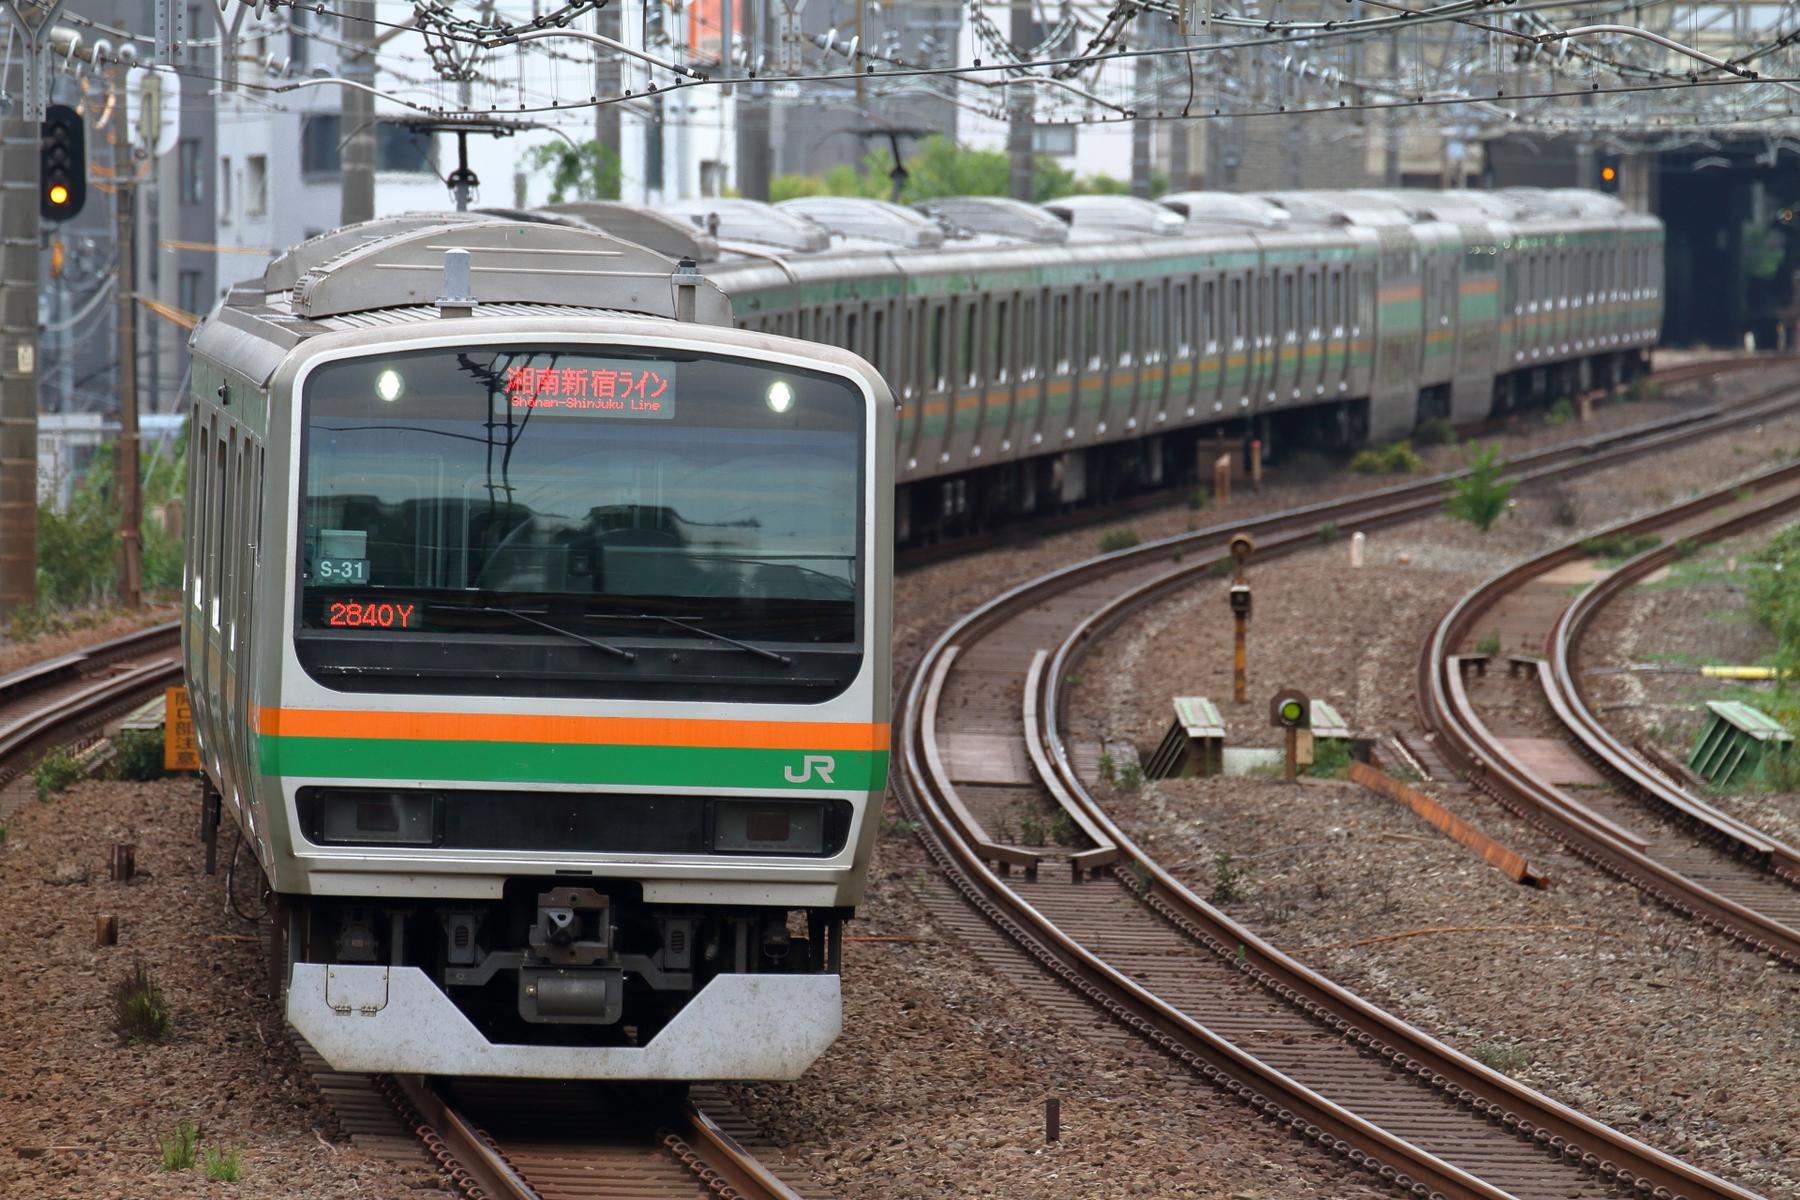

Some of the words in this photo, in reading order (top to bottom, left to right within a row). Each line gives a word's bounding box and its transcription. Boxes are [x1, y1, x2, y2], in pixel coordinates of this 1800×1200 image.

[505, 366, 669, 399] 湘南新宿ライン
[630, 399, 661, 411] Line
[320, 561, 363, 578] S-31
[330, 602, 415, 628] 2840Y
[784, 754, 835, 784] JR
